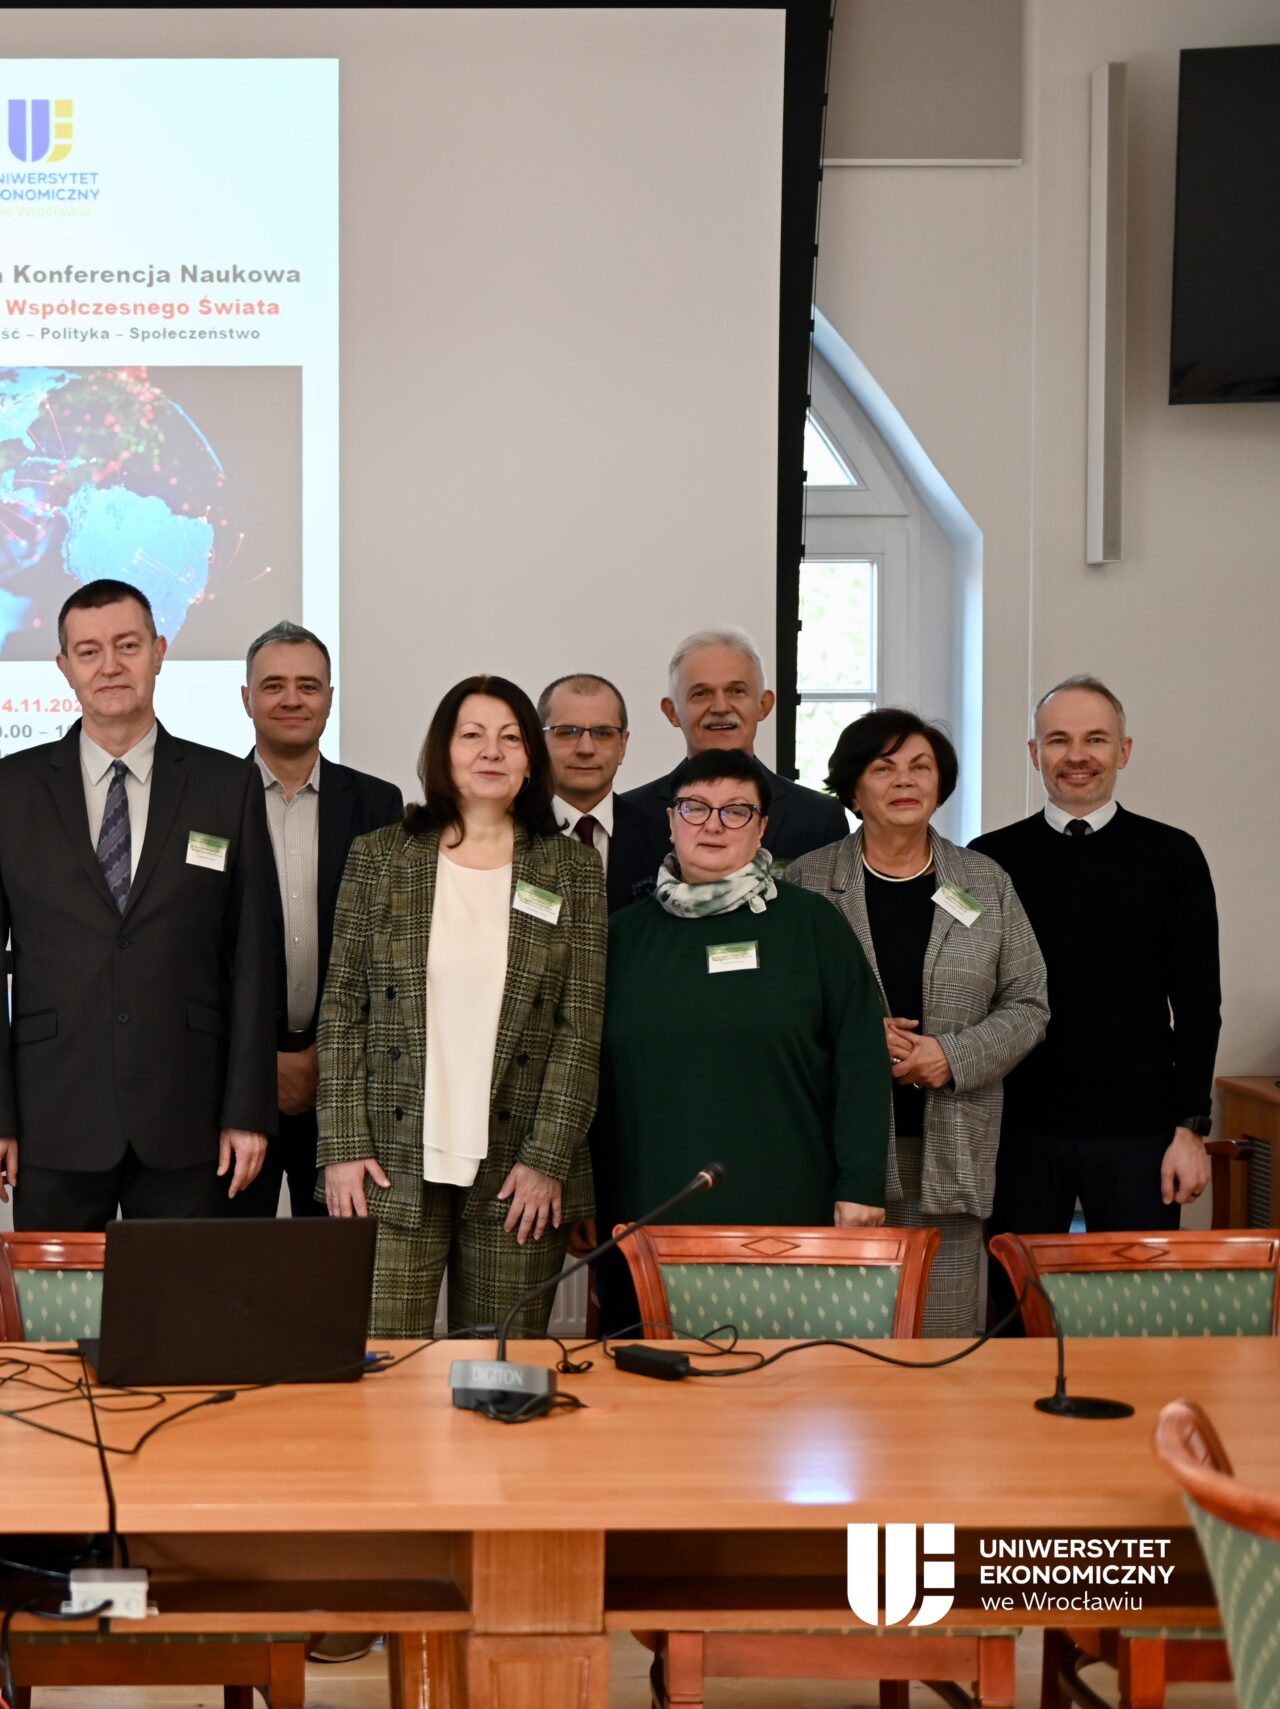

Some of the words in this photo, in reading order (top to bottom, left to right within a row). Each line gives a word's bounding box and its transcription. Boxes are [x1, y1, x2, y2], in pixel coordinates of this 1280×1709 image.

[13, 264, 171, 288] Konferencja
[180, 264, 301, 284] Naukowa
[6, 298, 190, 320] Współczesnego
[198, 297, 280, 316] Świata
[40, 327, 110, 343] Polityka
[129, 326, 261, 343] Społeczeństwo
[471, 1365, 524, 1386] DIGITON
